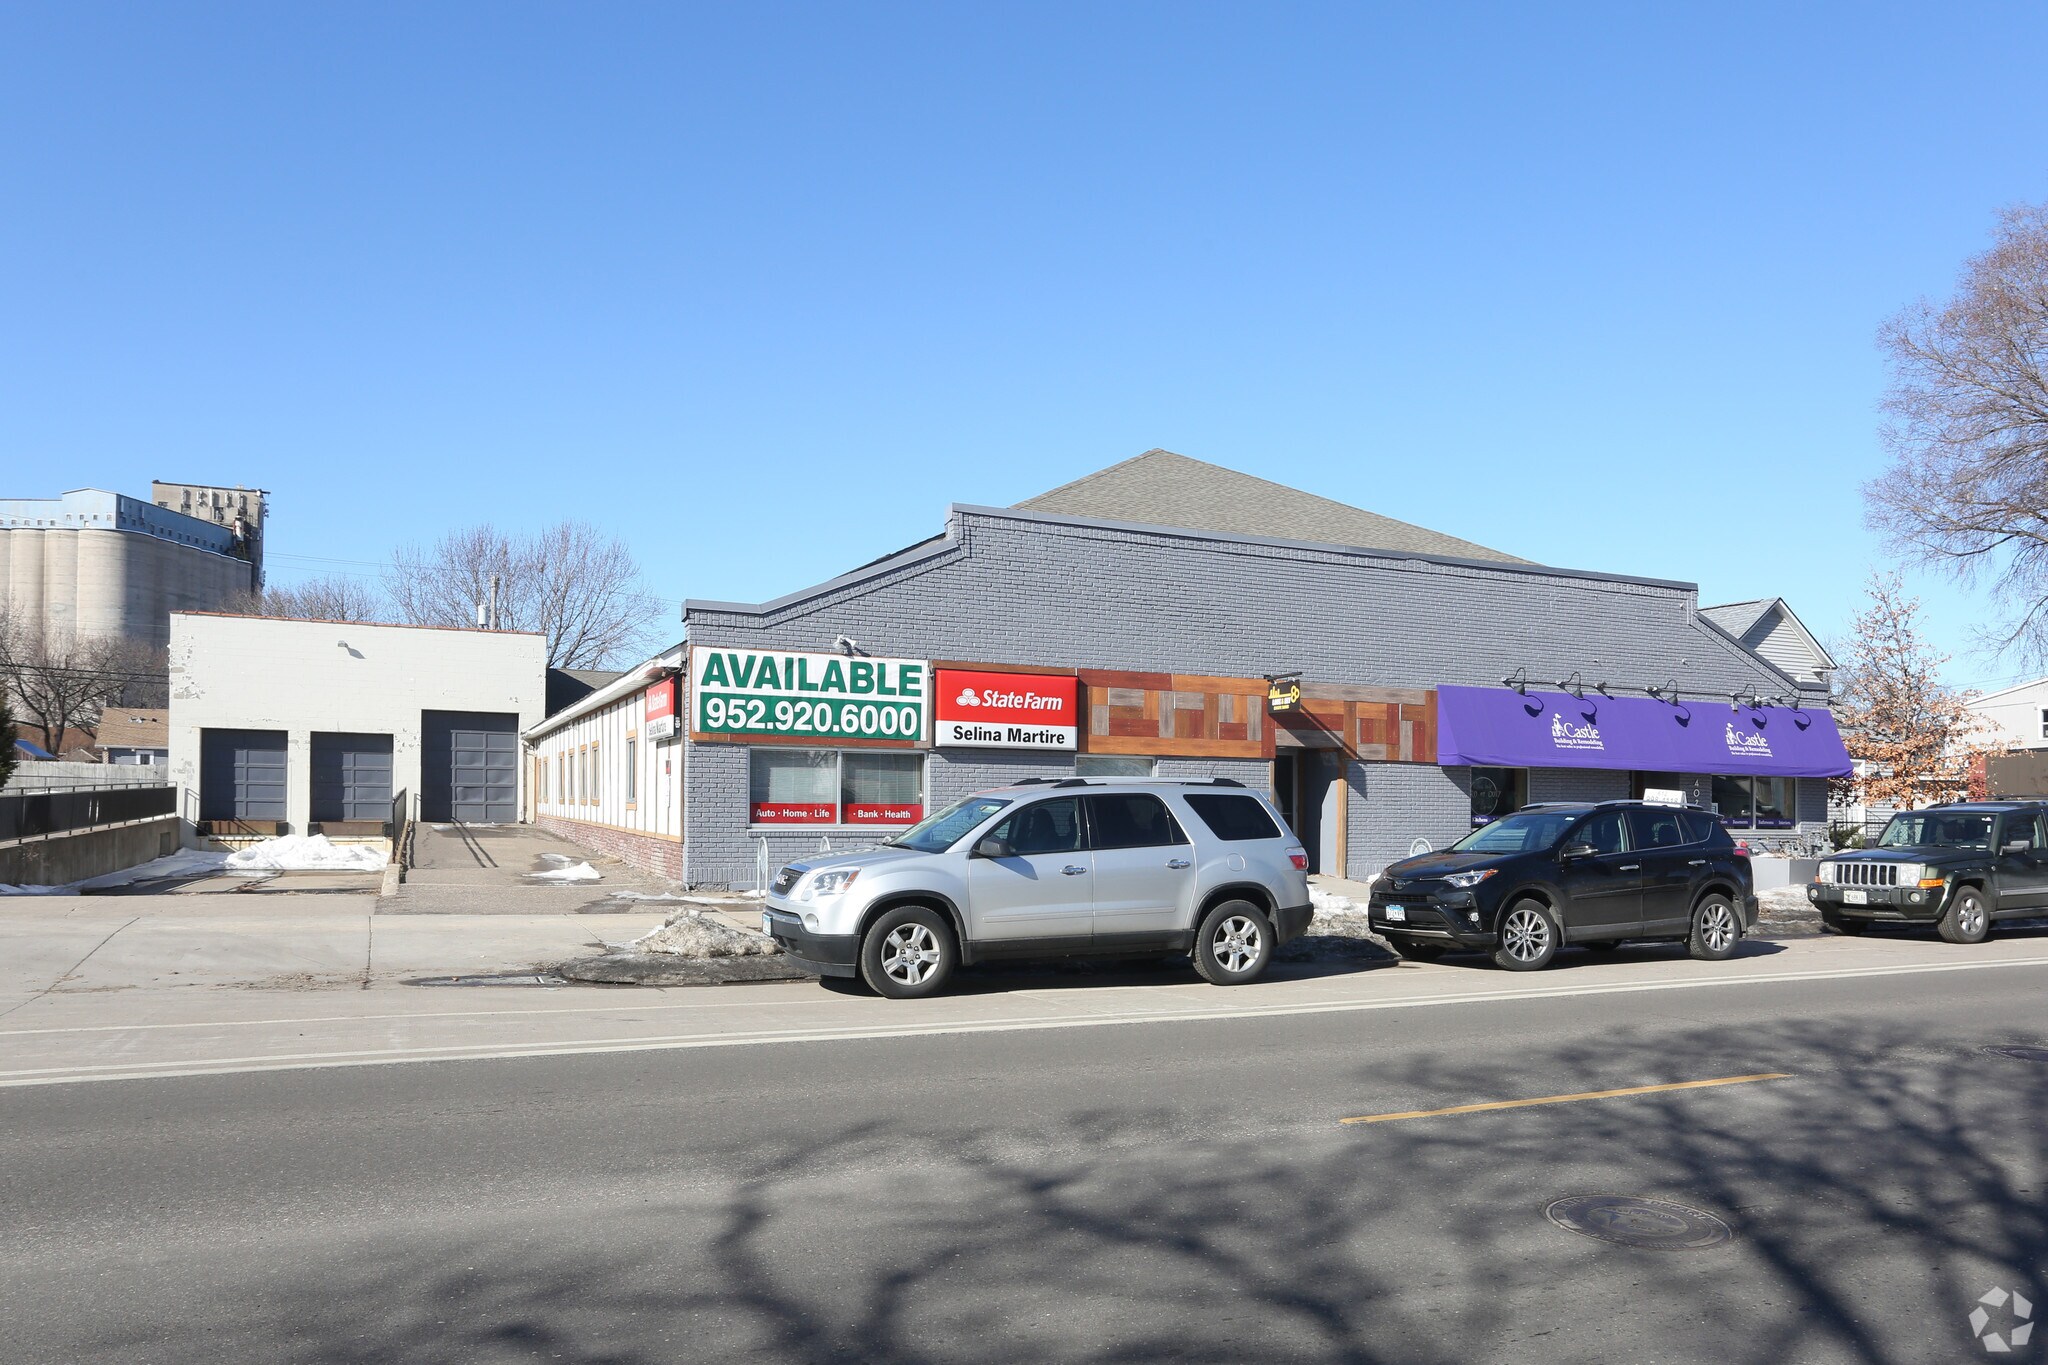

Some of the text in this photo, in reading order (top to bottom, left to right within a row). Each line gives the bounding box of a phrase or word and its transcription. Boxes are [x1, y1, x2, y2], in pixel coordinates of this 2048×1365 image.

[700, 652, 922, 697] AVAILABLE
[706, 697, 918, 736] 952.920.6000
[953, 725, 1065, 744] Selina Martire
[1563, 722, 1600, 739] Castle
[1736, 731, 1768, 747] Castle
[756, 808, 830, 818] Auto Home Life
[857, 809, 911, 819] Bank Health
